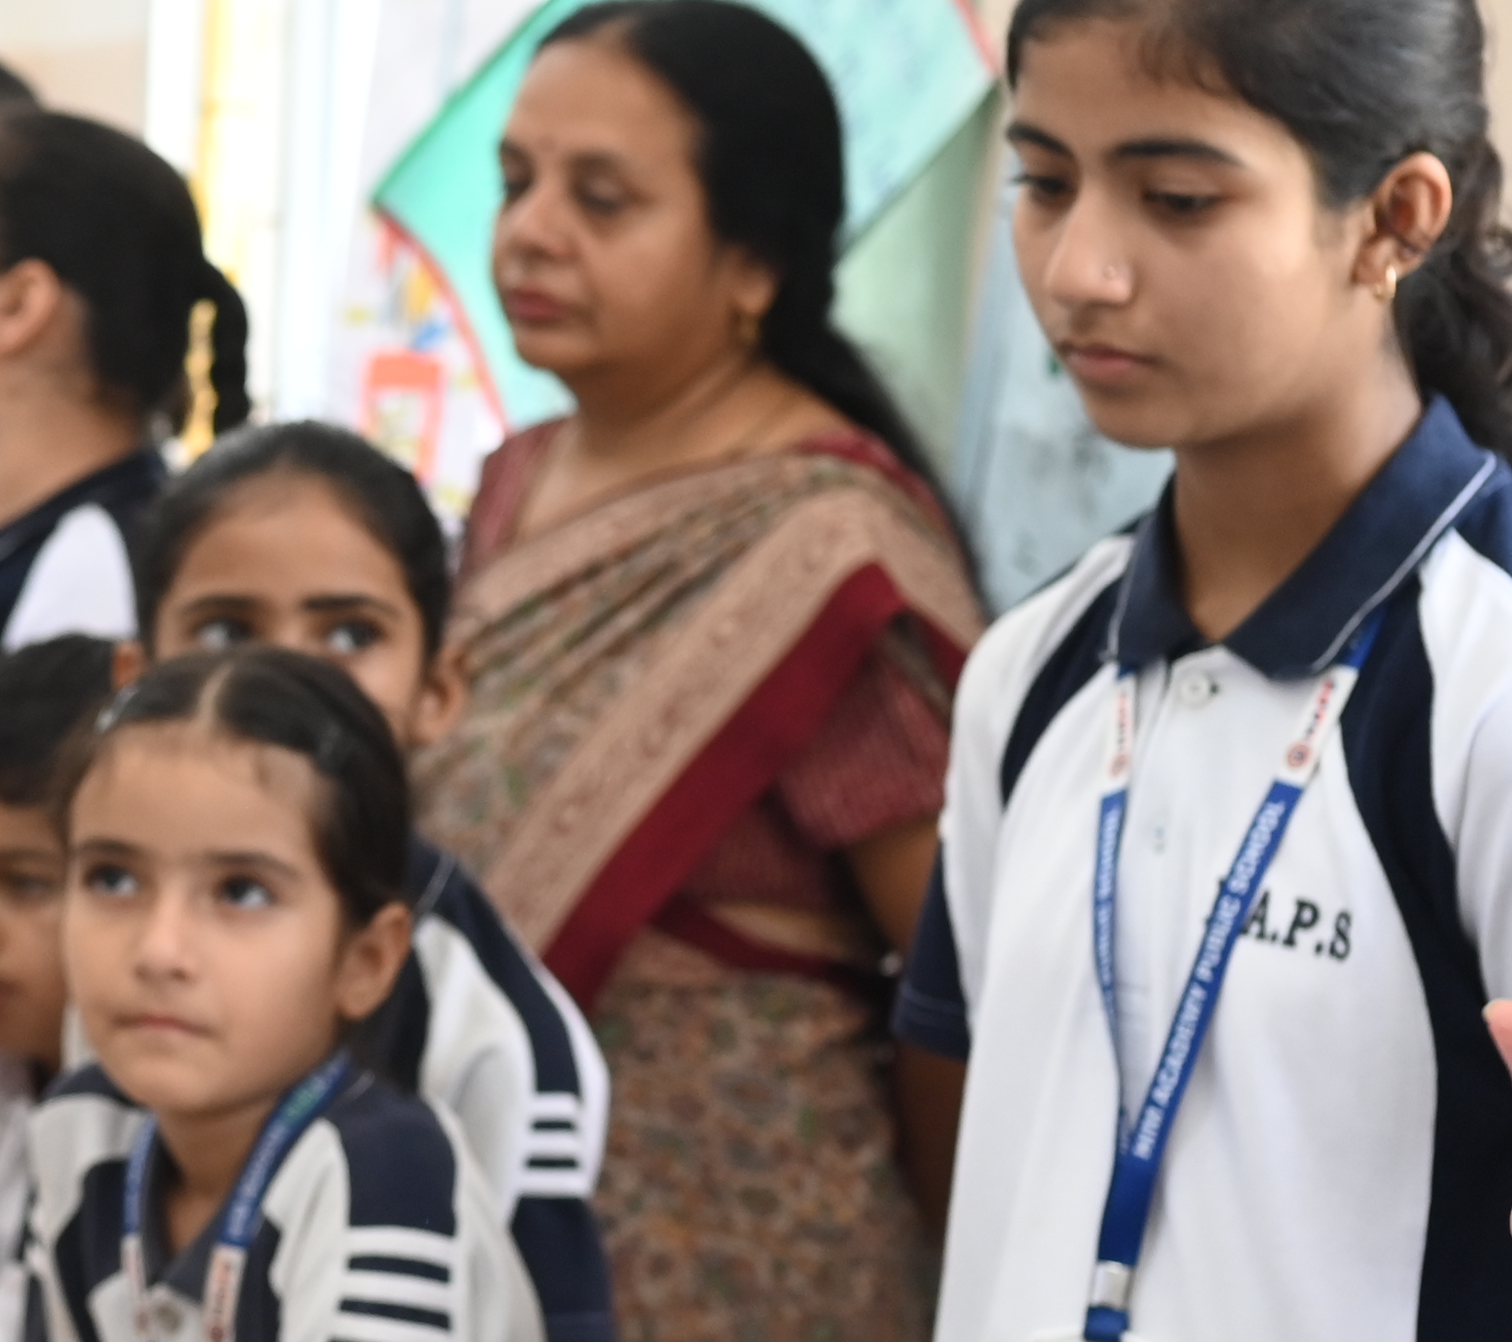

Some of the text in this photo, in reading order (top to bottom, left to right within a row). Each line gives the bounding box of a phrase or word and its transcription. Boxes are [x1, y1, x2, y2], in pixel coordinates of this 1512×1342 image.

[1195, 894, 1241, 982] PUBLIC
[1227, 801, 1285, 895] SCHOOL
[1207, 876, 1352, 960] A.P.S
